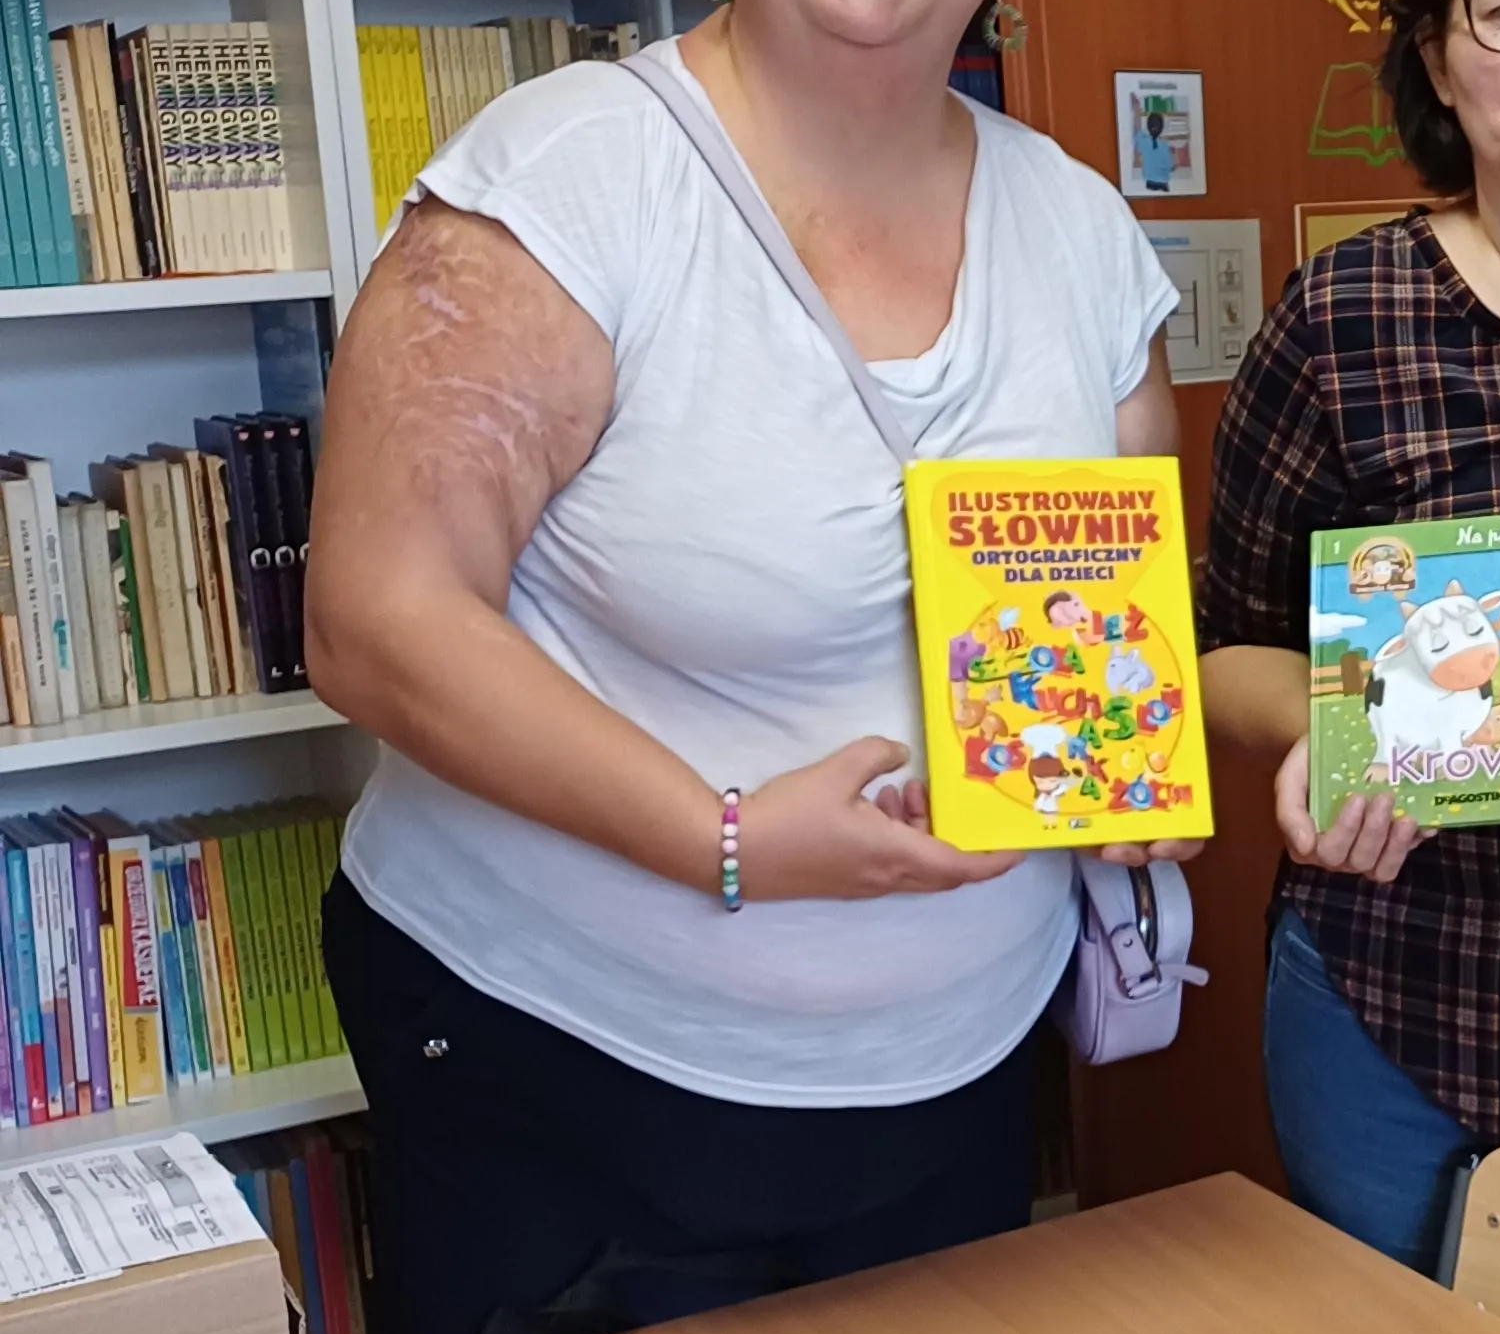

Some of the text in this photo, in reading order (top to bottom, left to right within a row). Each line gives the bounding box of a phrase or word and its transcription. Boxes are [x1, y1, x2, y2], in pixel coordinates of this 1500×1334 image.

[151, 46, 183, 169] HEMINGWAY
[172, 45, 202, 168] HEMINGWAY
[193, 45, 222, 168] HEMINGWAY
[213, 44, 241, 167] HEMINGWAY
[232, 43, 260, 167] HEMINGWAY
[254, 43, 281, 167] HEMINGWAY
[947, 490, 1156, 513] ILUSTROWANY
[948, 513, 1162, 548] SŁOWNIK
[1456, 527, 1483, 547] Na
[971, 547, 1142, 565] ORTOGRAFICZNY
[1004, 565, 1115, 583] DLA DZIECI
[1332, 540, 1340, 555] 1
